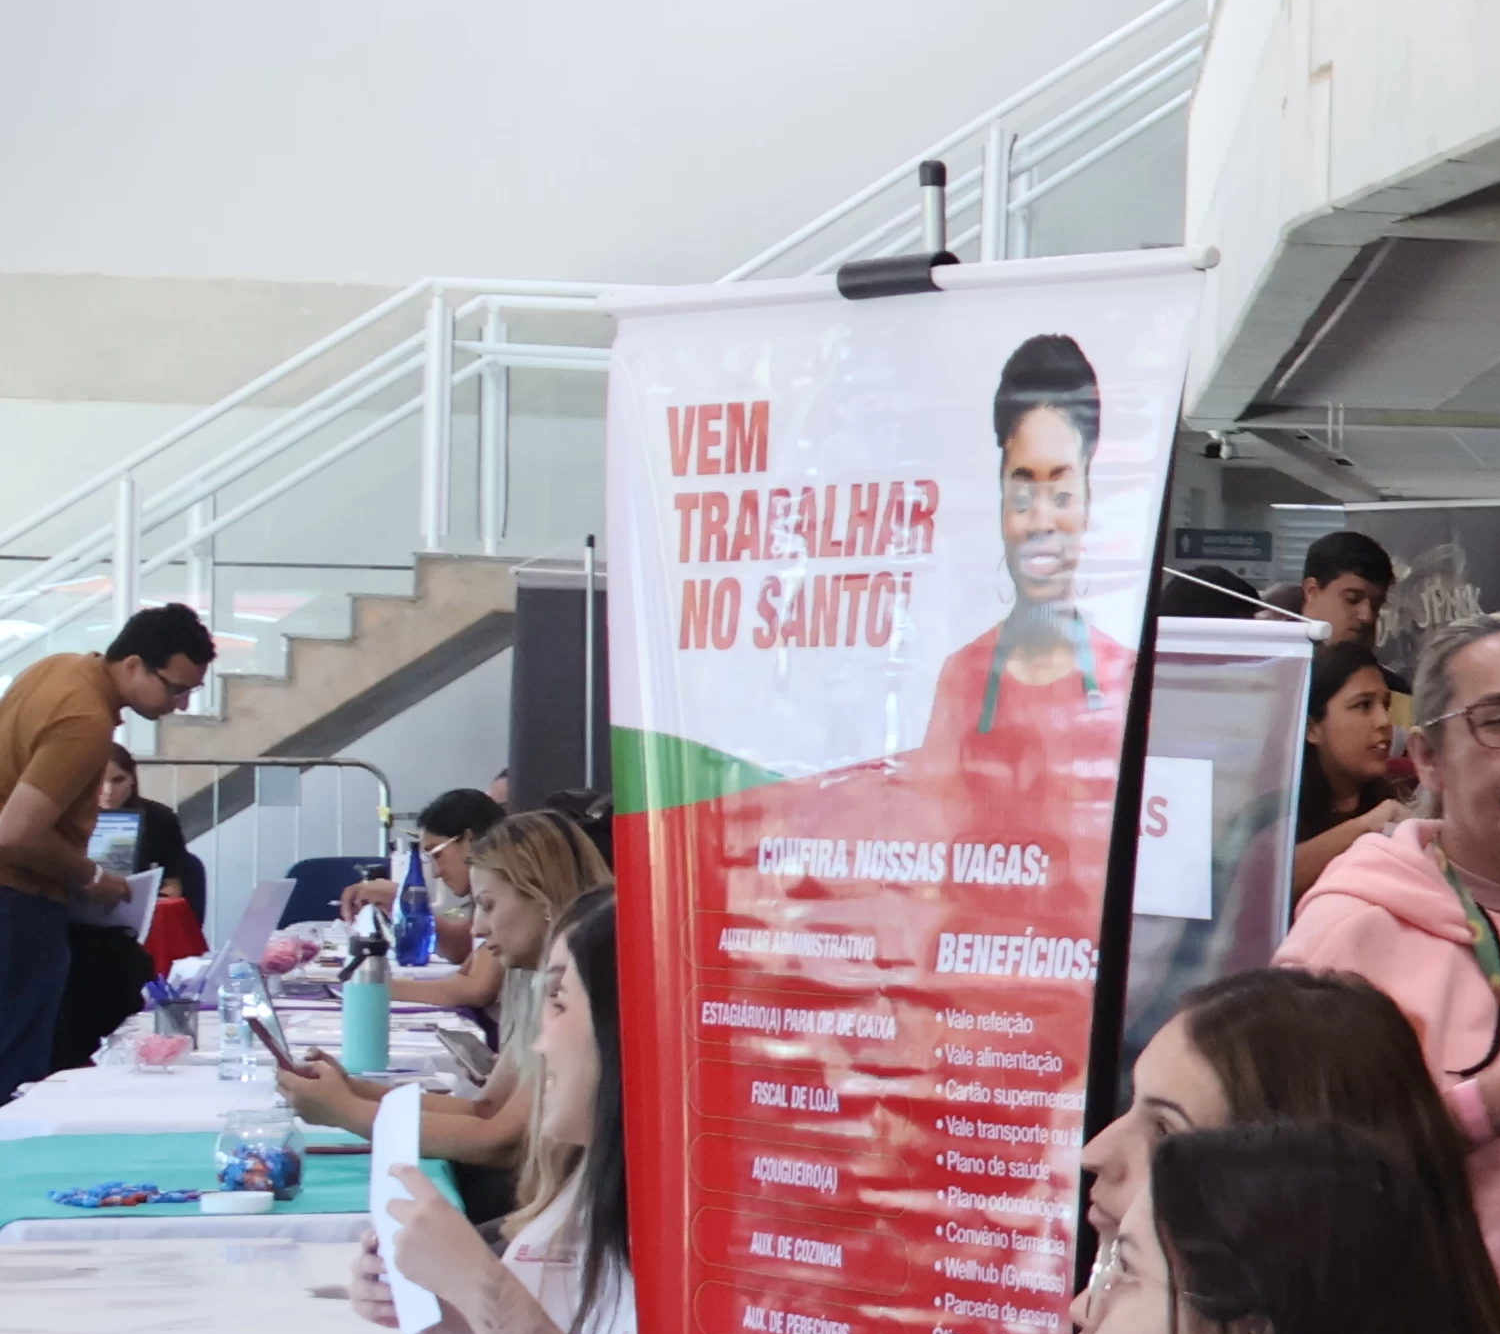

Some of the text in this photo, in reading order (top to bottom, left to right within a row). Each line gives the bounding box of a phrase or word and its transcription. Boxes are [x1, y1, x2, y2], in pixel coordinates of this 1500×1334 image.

[667, 400, 770, 476] VEM
[674, 479, 939, 563] TRABALHAR
[678, 576, 741, 650] NO
[757, 835, 1049, 886] CONFIRA NOSSAS VAGAS:
[718, 927, 876, 961] AUXILIAR ADMINISTRATIVO
[935, 926, 1099, 982] BENEFÍCIOS:
[701, 999, 782, 1035] ESTAGIÁRIO(A)
[783, 1009, 815, 1034] PARA
[835, 1011, 855, 1037] DE
[856, 1014, 897, 1040] CAIXA
[945, 1008, 1033, 1038] Vale refeição
[945, 1043, 1062, 1077] Vale alimentação
[751, 1080, 840, 1113] FISCAL DE LOJA
[945, 1078, 991, 1103] Cartão
[945, 1115, 974, 1138] Vale
[977, 1119, 1048, 1146] transporte
[1052, 1130, 1069, 1144] ou
[752, 1155, 839, 1195] AÇOUGUEIRO(A)
[946, 1150, 1051, 1181] Plano de saúde
[947, 1185, 987, 1210] Plano
[750, 1231, 843, 1268] AUX. DE COZINHA
[946, 1220, 1065, 1257] Convênio farmácia
[944, 1256, 1066, 1298] Wellhub (Gympass)
[743, 1305, 767, 1331] AUX.
[769, 1310, 785, 1334] DE
[944, 1292, 1059, 1329] Parceria de ensino
